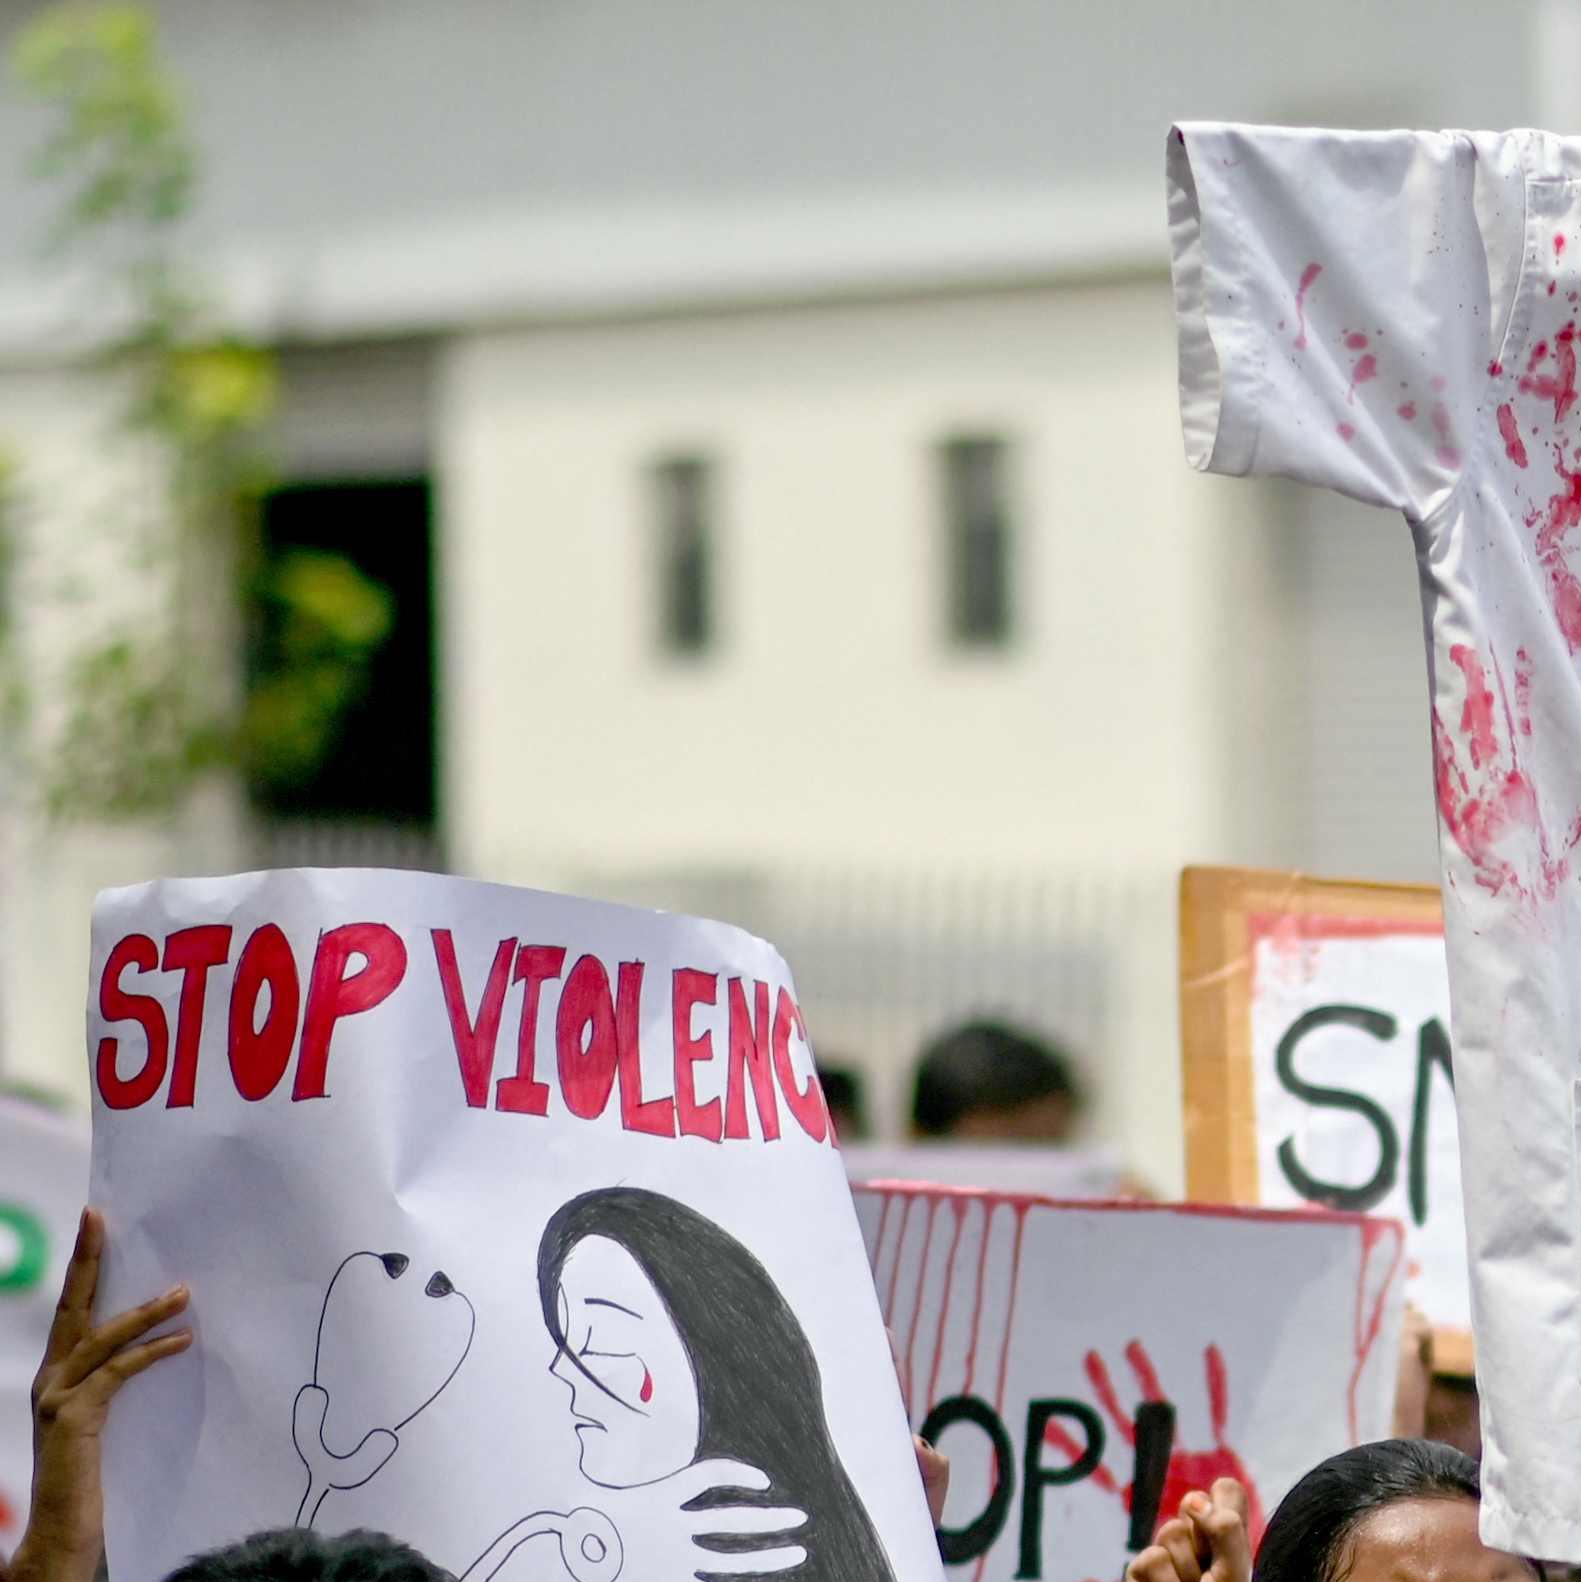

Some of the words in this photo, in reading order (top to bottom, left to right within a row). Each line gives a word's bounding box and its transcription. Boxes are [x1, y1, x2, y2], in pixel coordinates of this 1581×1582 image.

[96, 921, 408, 1111] STOP
[430, 927, 840, 1150] VIOLENC
[919, 1394, 1177, 1582] OP!
